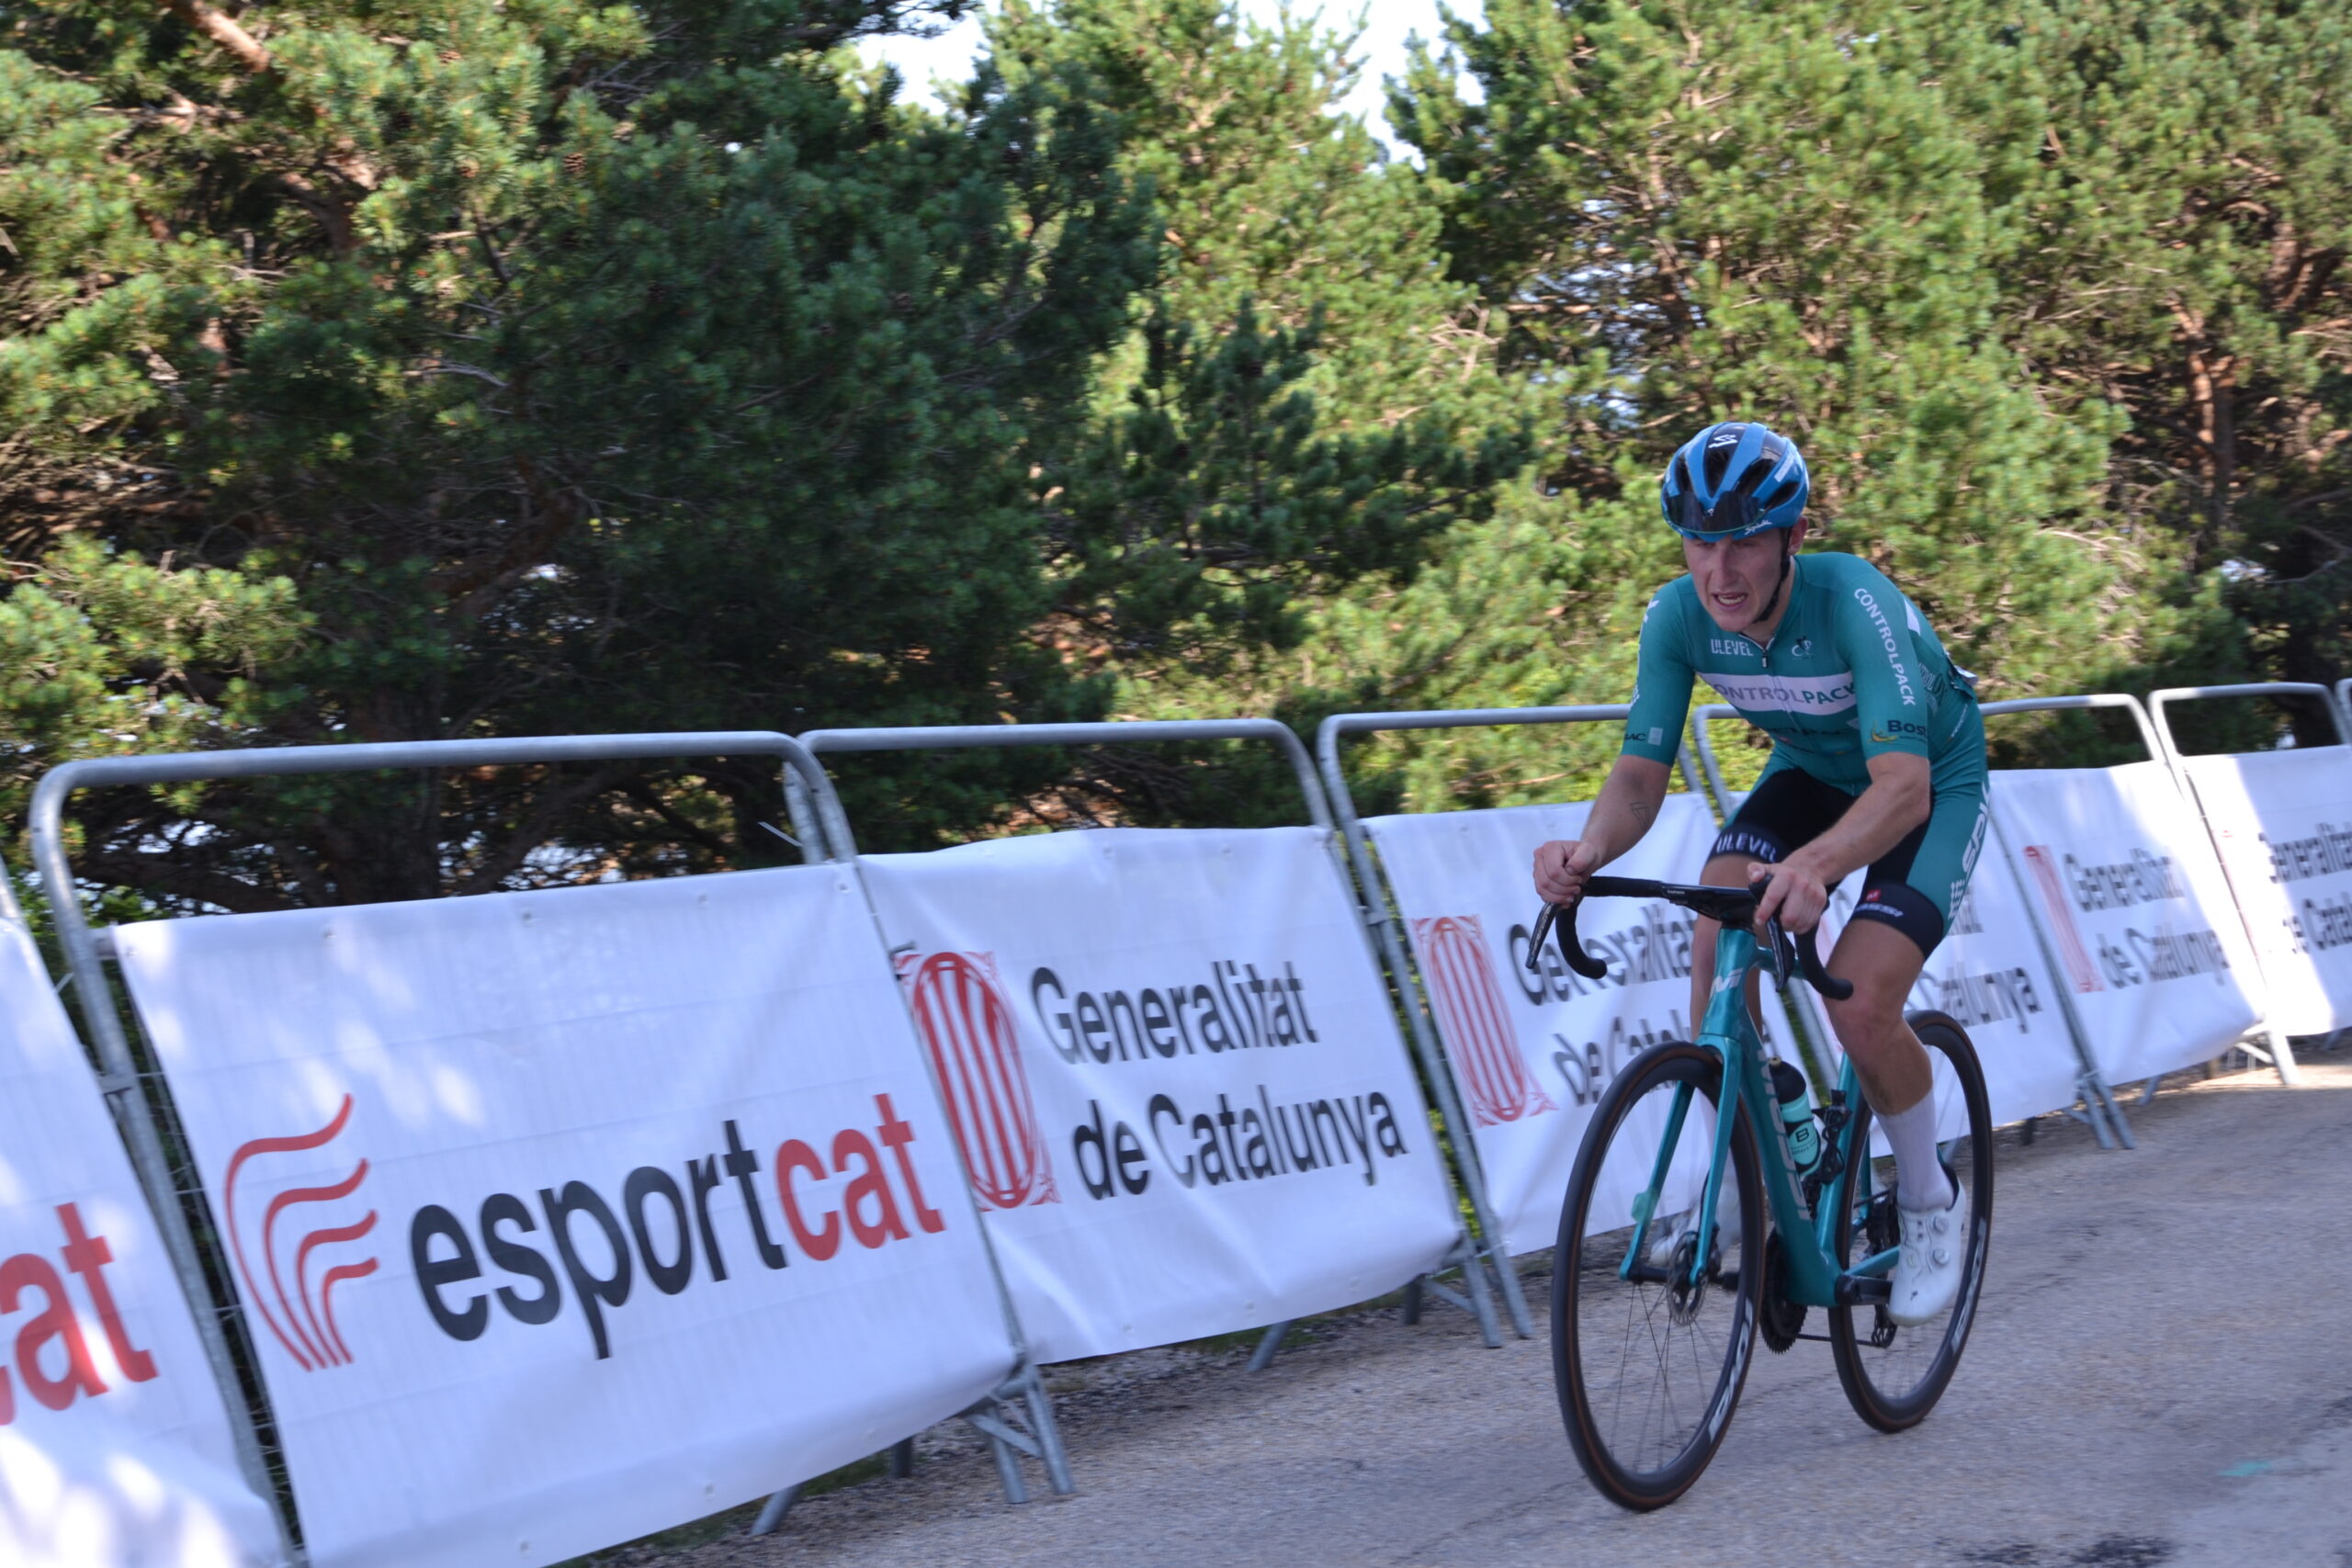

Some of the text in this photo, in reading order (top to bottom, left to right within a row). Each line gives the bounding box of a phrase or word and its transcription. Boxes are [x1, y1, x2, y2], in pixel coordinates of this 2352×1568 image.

[1854, 588, 1916, 706] CONTROLPACK
[1030, 960, 1320, 1065] Generalitat
[1072, 1085, 1409, 1201] de Catalunya
[409, 1092, 947, 1360] esportcat
[0, 1201, 160, 1427] at
